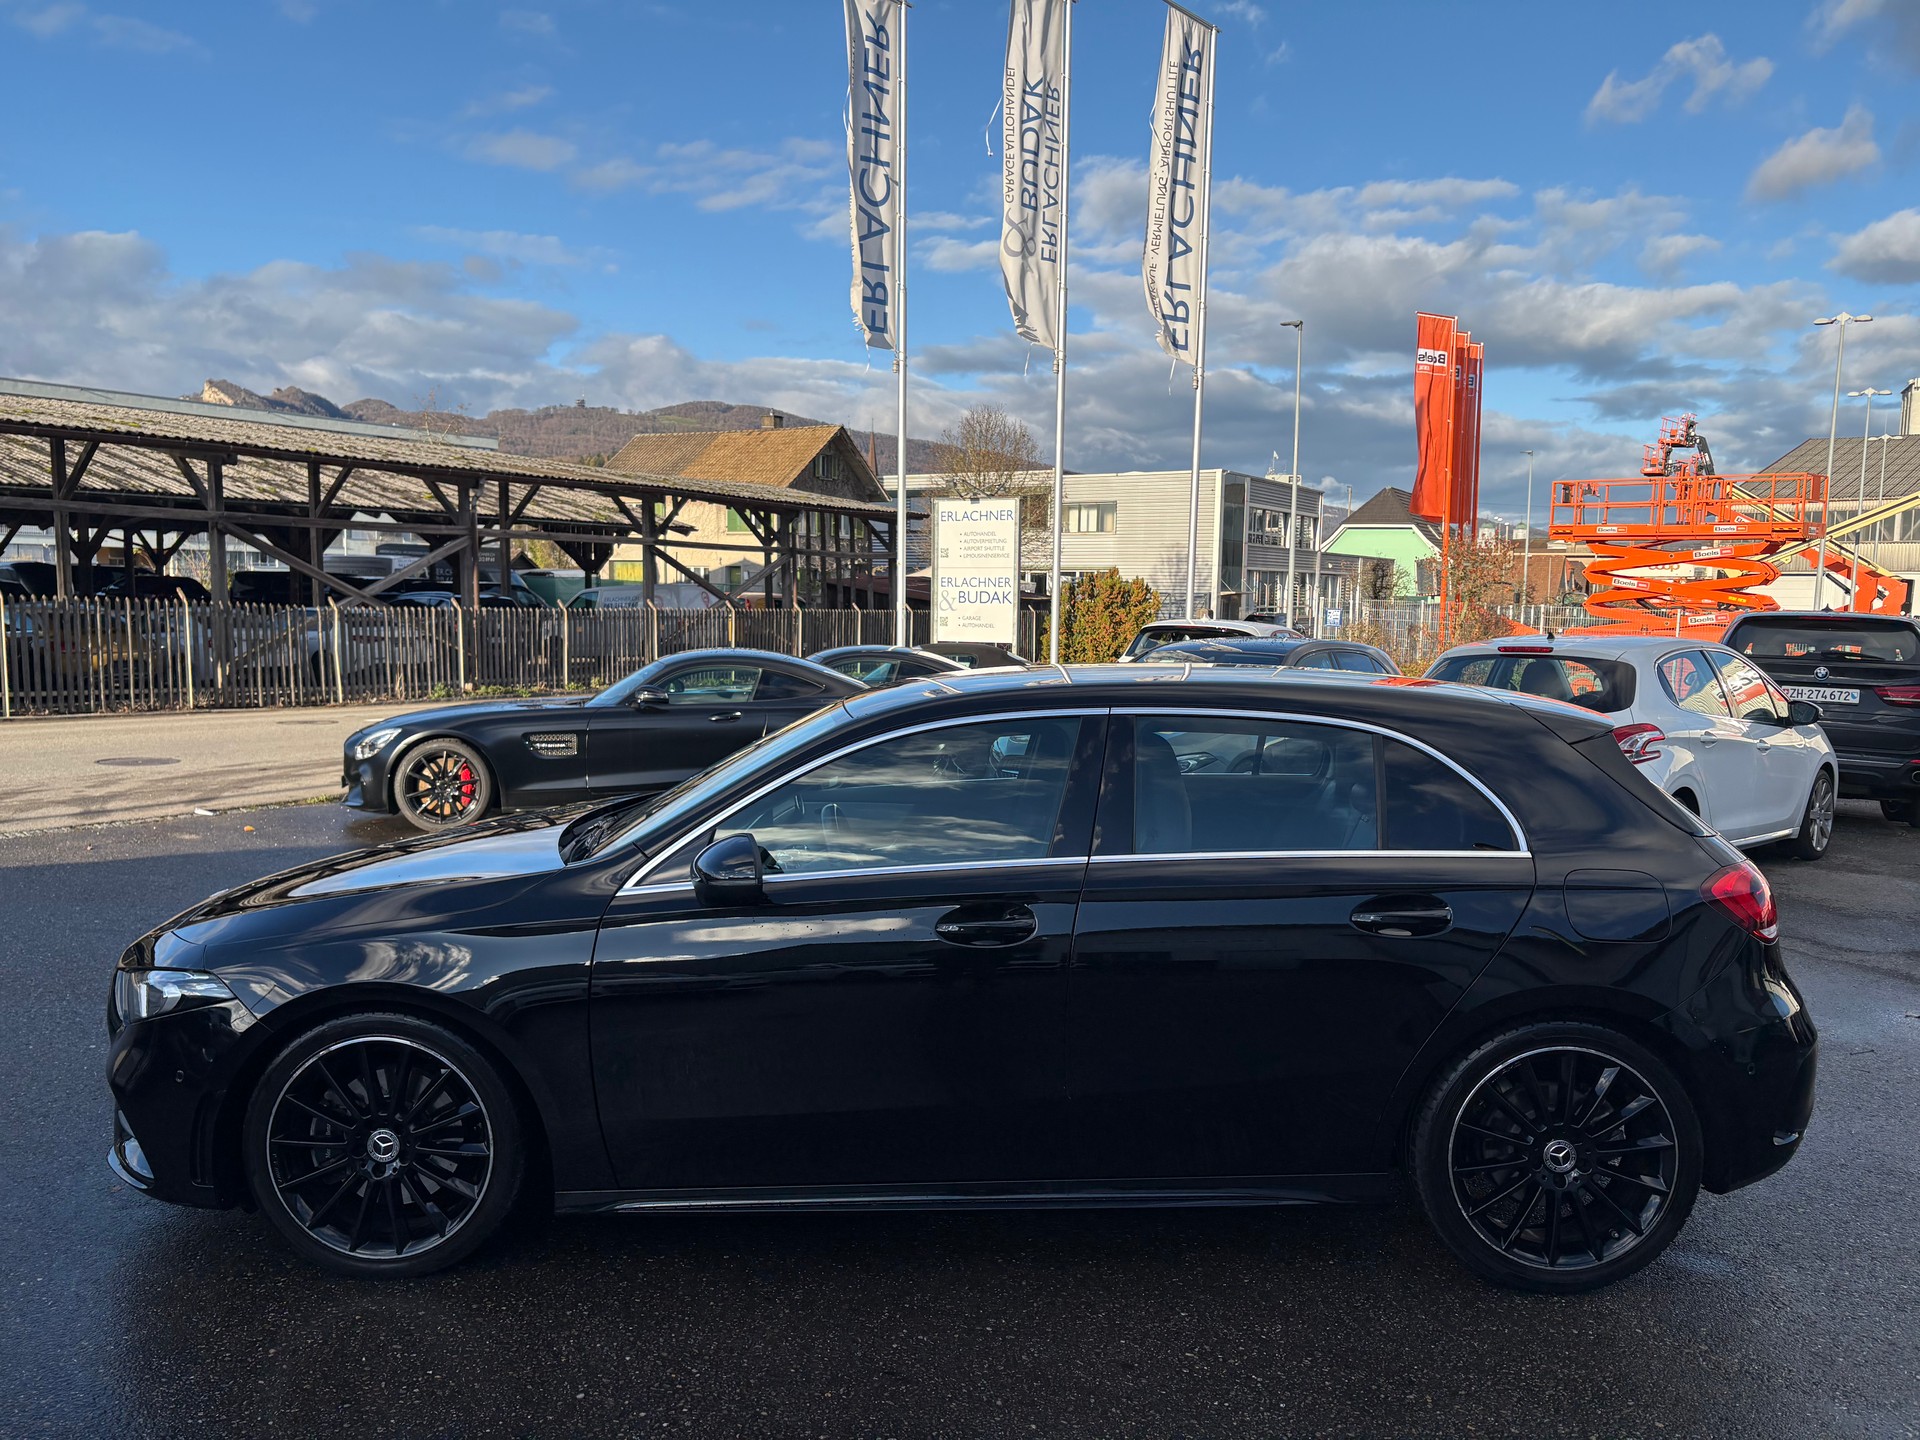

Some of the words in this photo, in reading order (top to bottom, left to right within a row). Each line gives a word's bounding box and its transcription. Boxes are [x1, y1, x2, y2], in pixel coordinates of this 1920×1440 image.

[940, 510, 1014, 522] ERLACHNER
[1694, 550, 1719, 558] Boels
[940, 577, 1012, 588] ERLACHNER
[1613, 578, 1636, 588] Boels
[939, 590, 957, 611] &
[958, 590, 1012, 604] BUDAK
[1689, 616, 1715, 624] Boels
